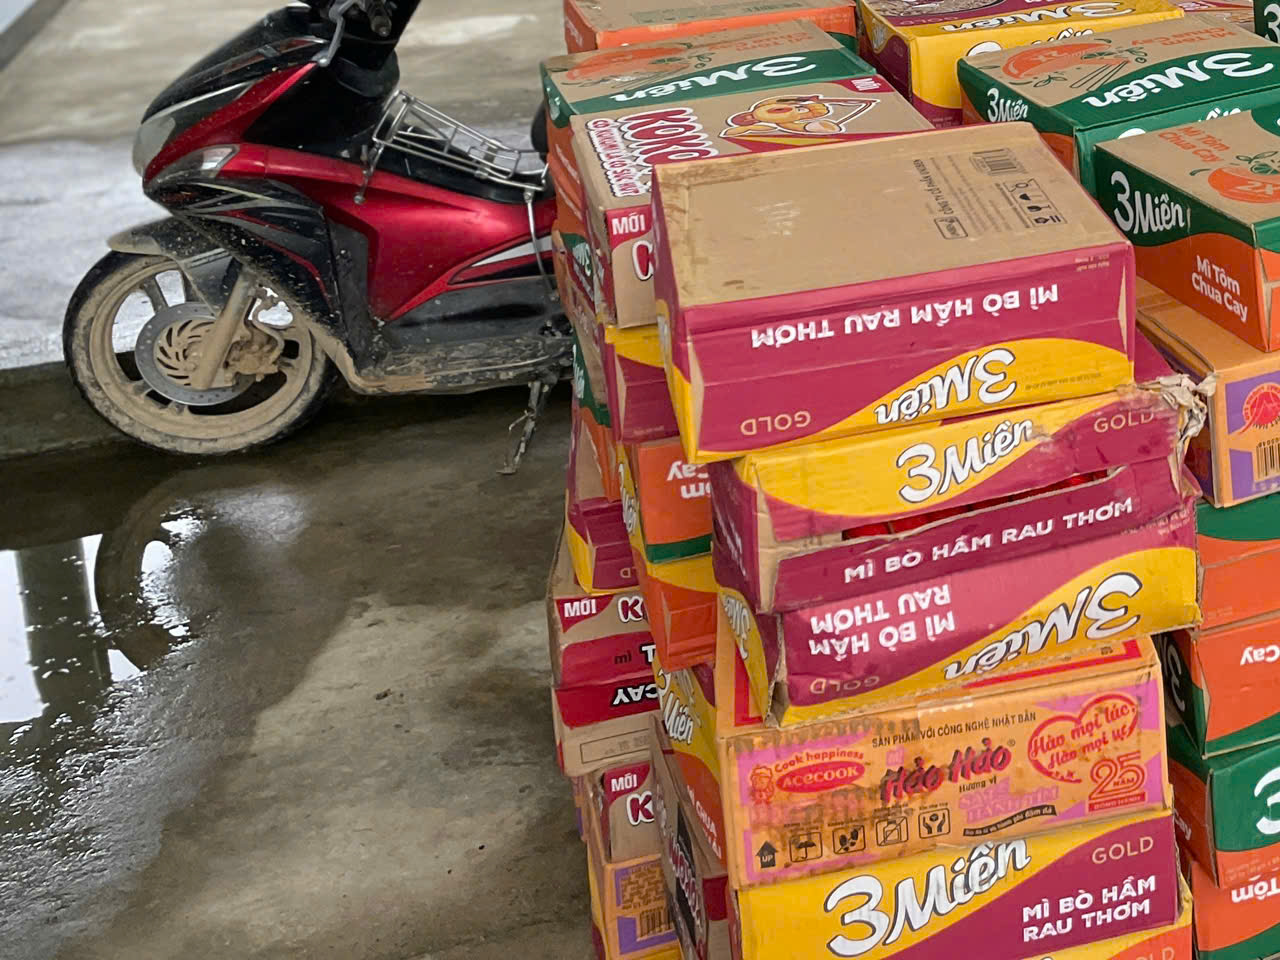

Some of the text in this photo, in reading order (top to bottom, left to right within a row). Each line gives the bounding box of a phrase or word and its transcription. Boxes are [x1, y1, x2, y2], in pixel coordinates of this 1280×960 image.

[1211, 264, 1241, 297] Tôm
[982, 290, 1021, 317] BÒ
[1029, 283, 1059, 310] MÌ
[1191, 273, 1248, 323] Chua Cay
[751, 319, 835, 349] THƠM
[843, 308, 901, 334] RAU
[740, 410, 812, 437] GOLD
[843, 559, 875, 584] MÌ
[884, 549, 922, 574] BÒ
[1001, 518, 1055, 545] RAU
[1062, 496, 1134, 529] THƠM
[810, 583, 951, 635] RAU THƠM
[878, 619, 917, 649] BÒ
[925, 610, 956, 642] MÌ
[805, 748, 865, 763] happiness
[1088, 751, 1146, 801] 25
[762, 855, 775, 864] UP
[1092, 836, 1155, 865] GOLD
[1023, 874, 1157, 923] MÌ BÒ HẦM
[1023, 899, 1151, 942] RAU THƠM
